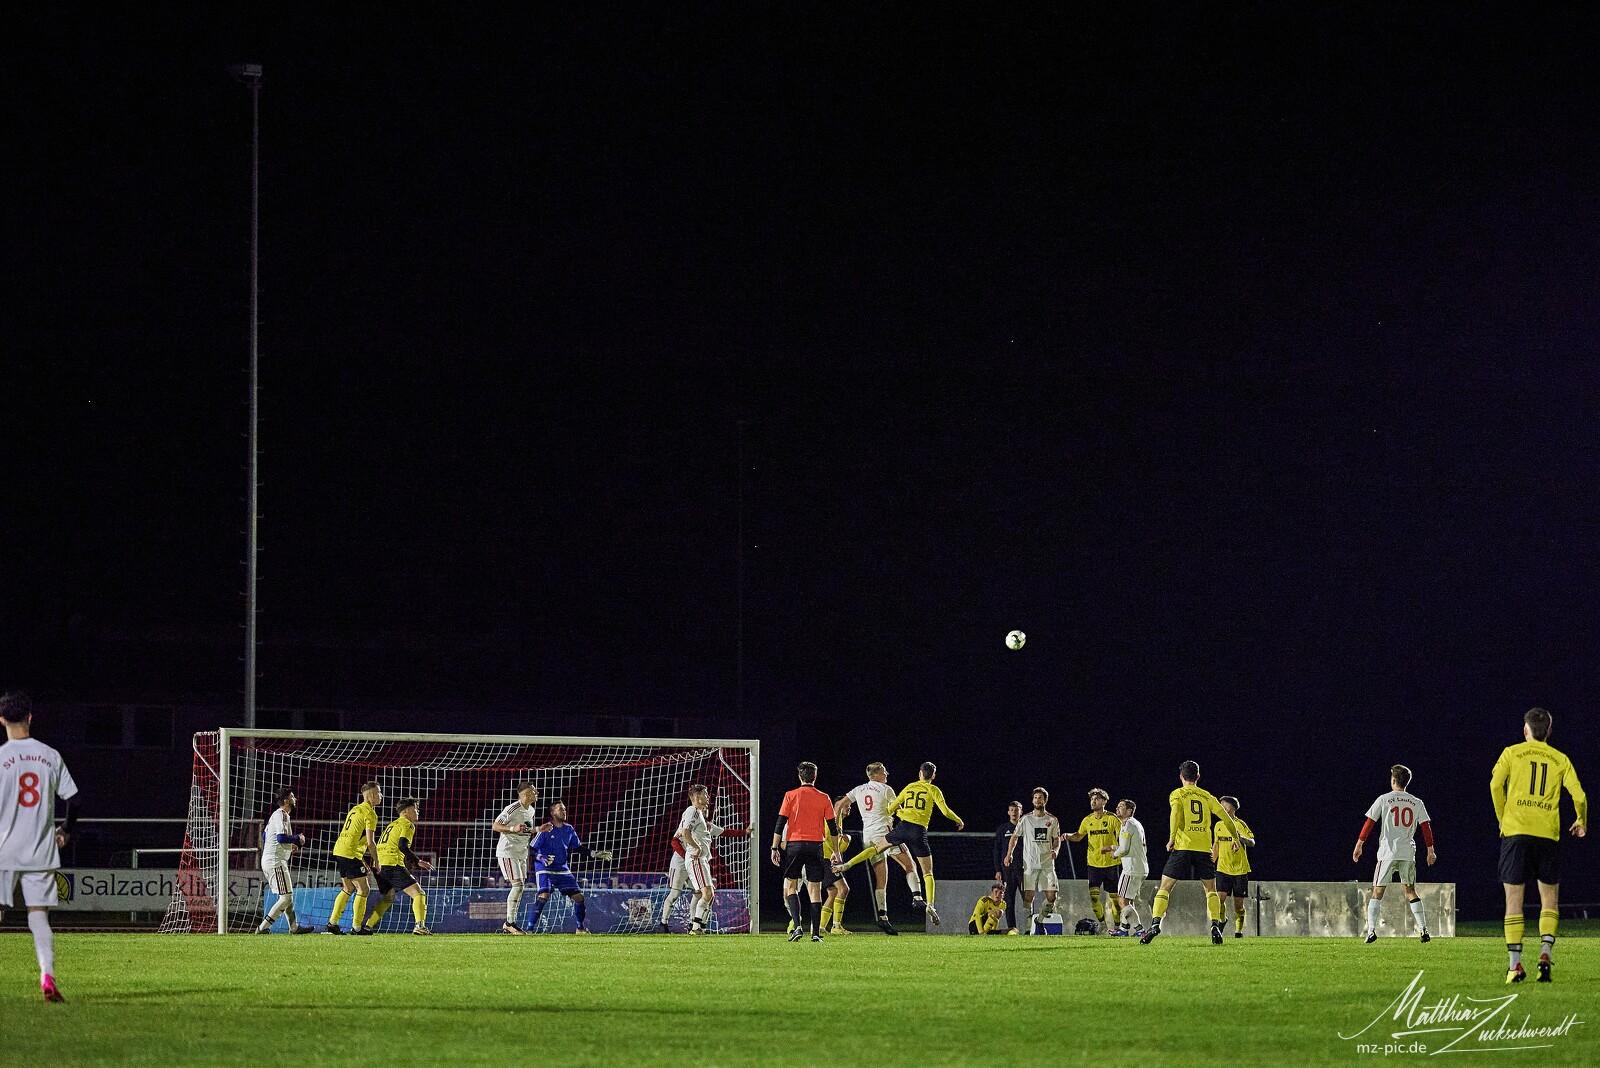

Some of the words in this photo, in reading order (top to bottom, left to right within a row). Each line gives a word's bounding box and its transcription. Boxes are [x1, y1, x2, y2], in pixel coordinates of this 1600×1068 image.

[3, 757, 16, 770] SV
[19, 754, 52, 768] Laufen
[1530, 761, 1548, 796] 11
[19, 772, 40, 808] 8
[905, 790, 927, 810] 26
[864, 794, 874, 811] 9
[1190, 799, 1204, 824] 9
[1516, 799, 1553, 811] BABINGER
[345, 812, 356, 831] 6
[1390, 806, 1414, 828] 10
